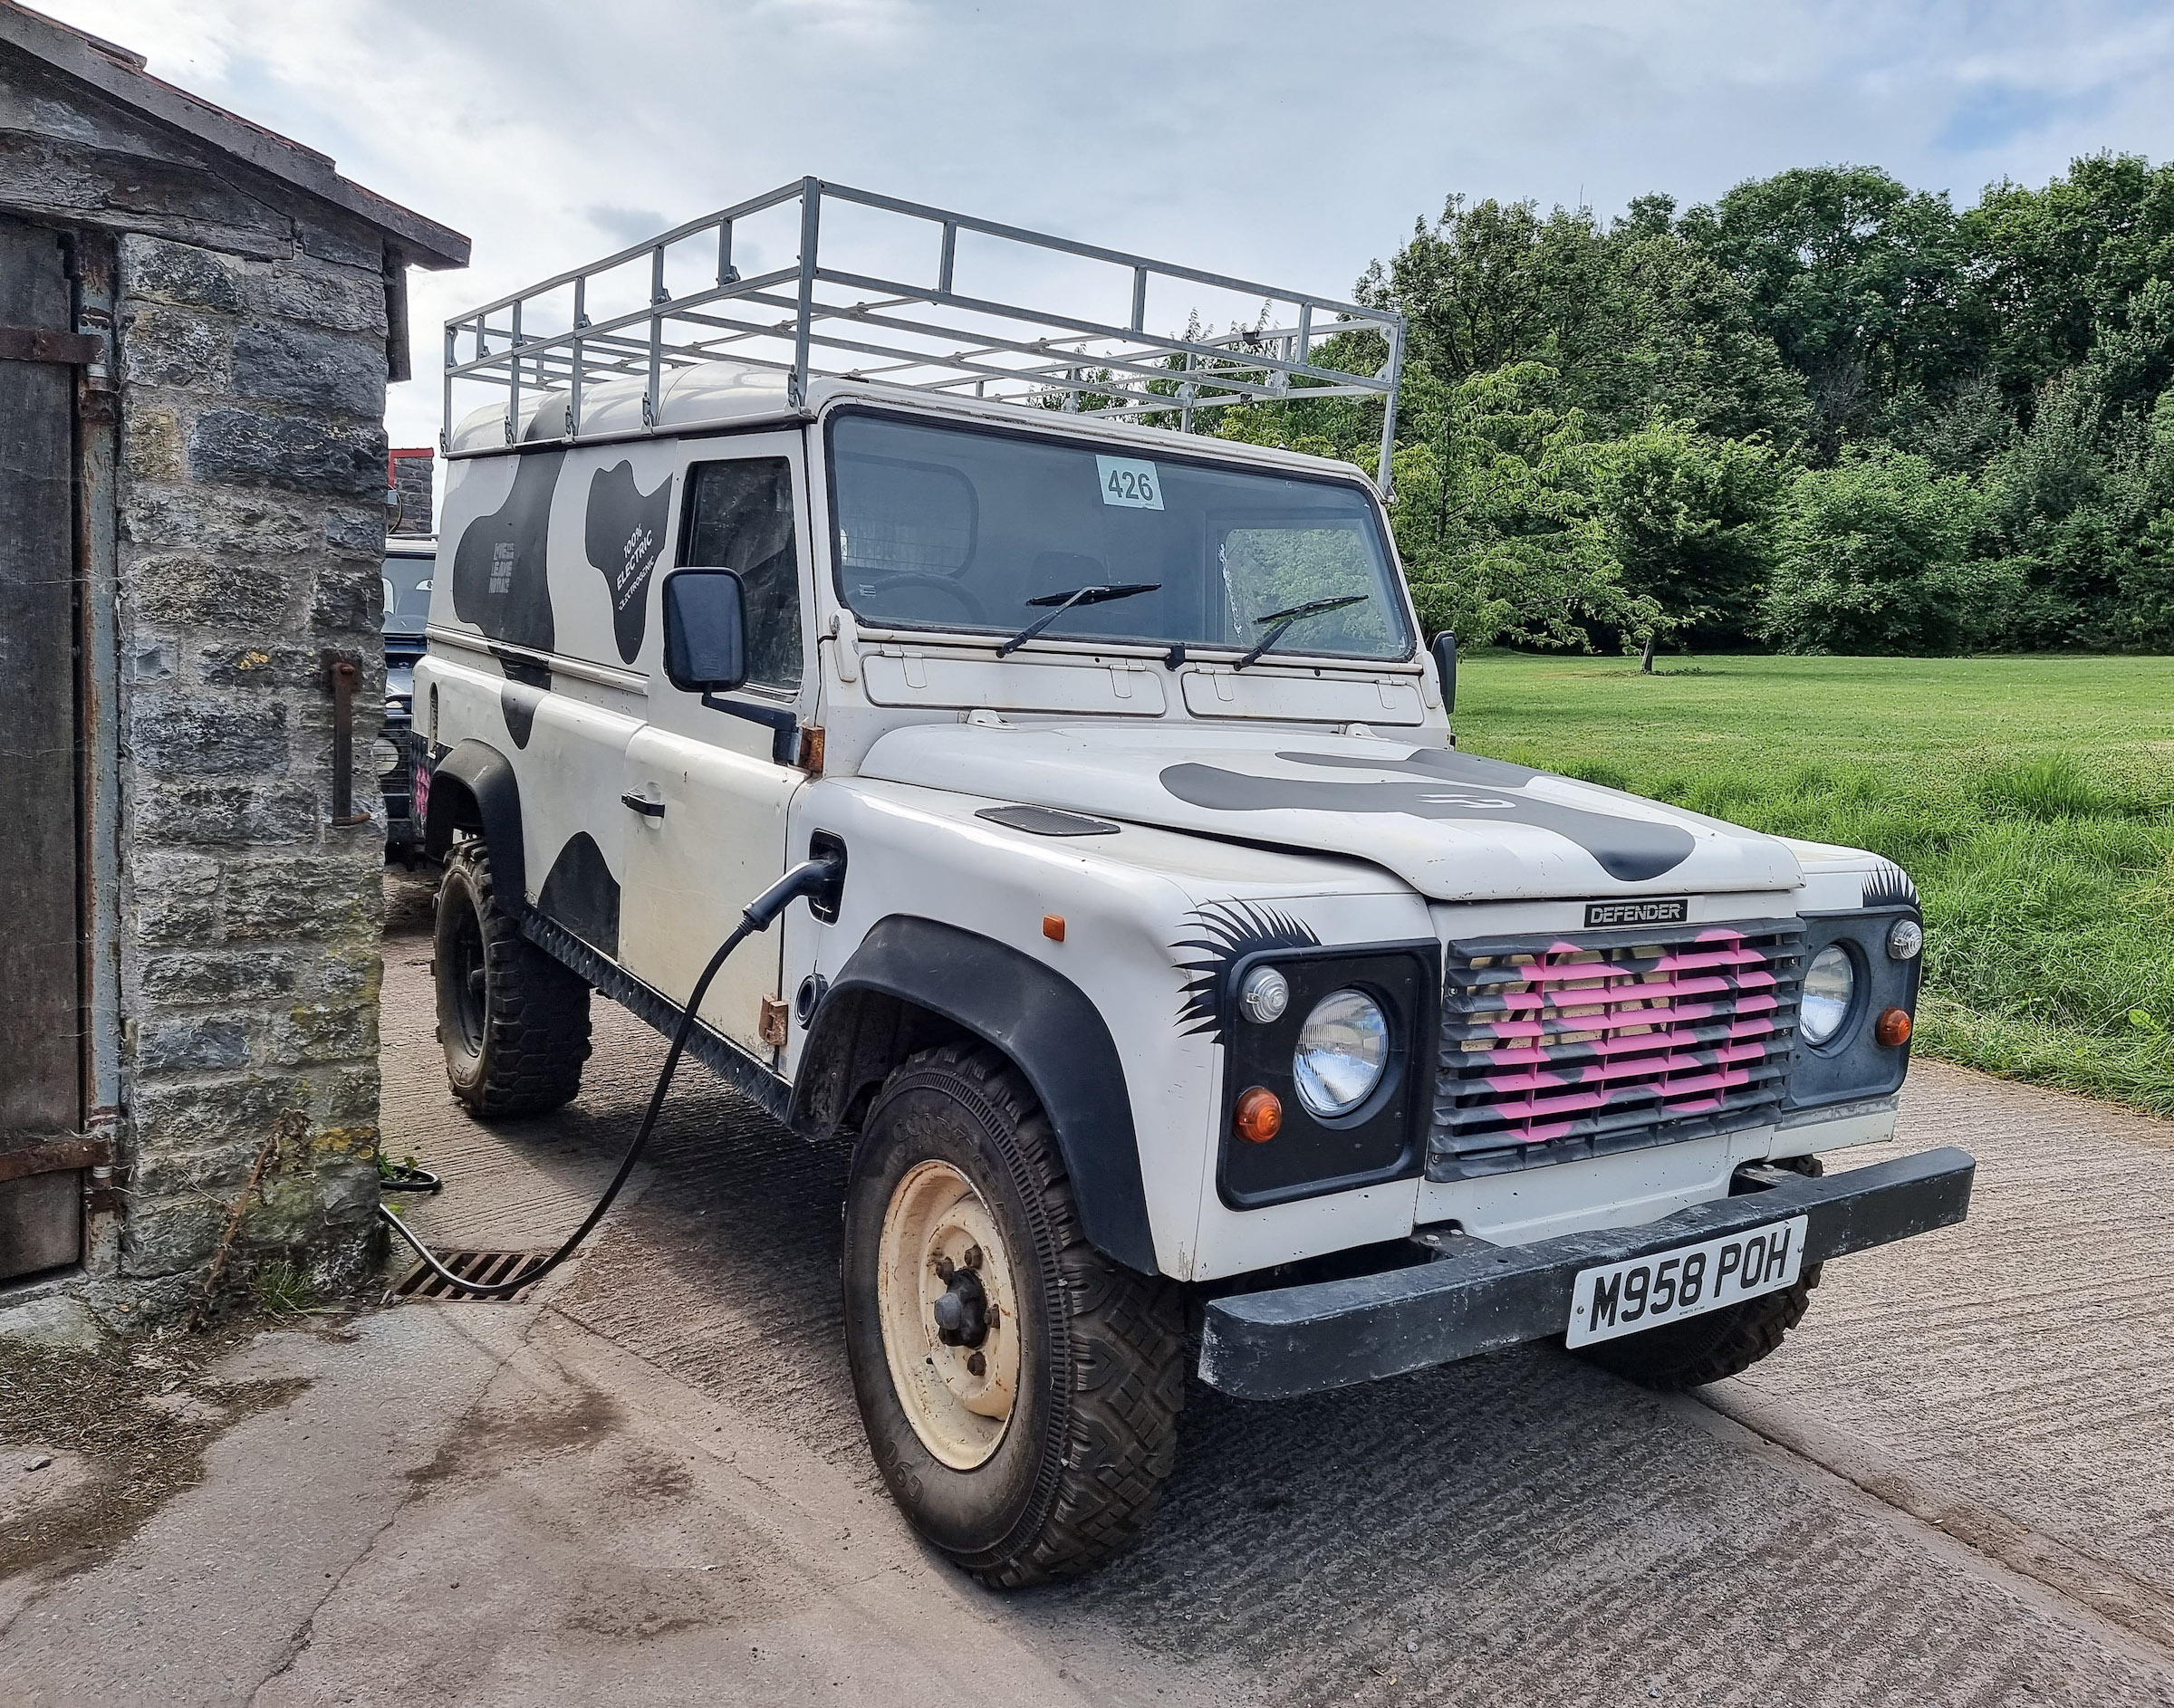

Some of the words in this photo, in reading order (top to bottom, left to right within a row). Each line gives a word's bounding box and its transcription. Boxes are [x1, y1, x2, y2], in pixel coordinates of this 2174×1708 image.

[1108, 469, 1154, 501] 426
[623, 523, 643, 559] 100%
[616, 529, 653, 591] ELECTRIC
[1590, 903, 1683, 924] DEFENDER
[1588, 1251, 1707, 1333] M958
[1713, 1227, 1792, 1299] POH
